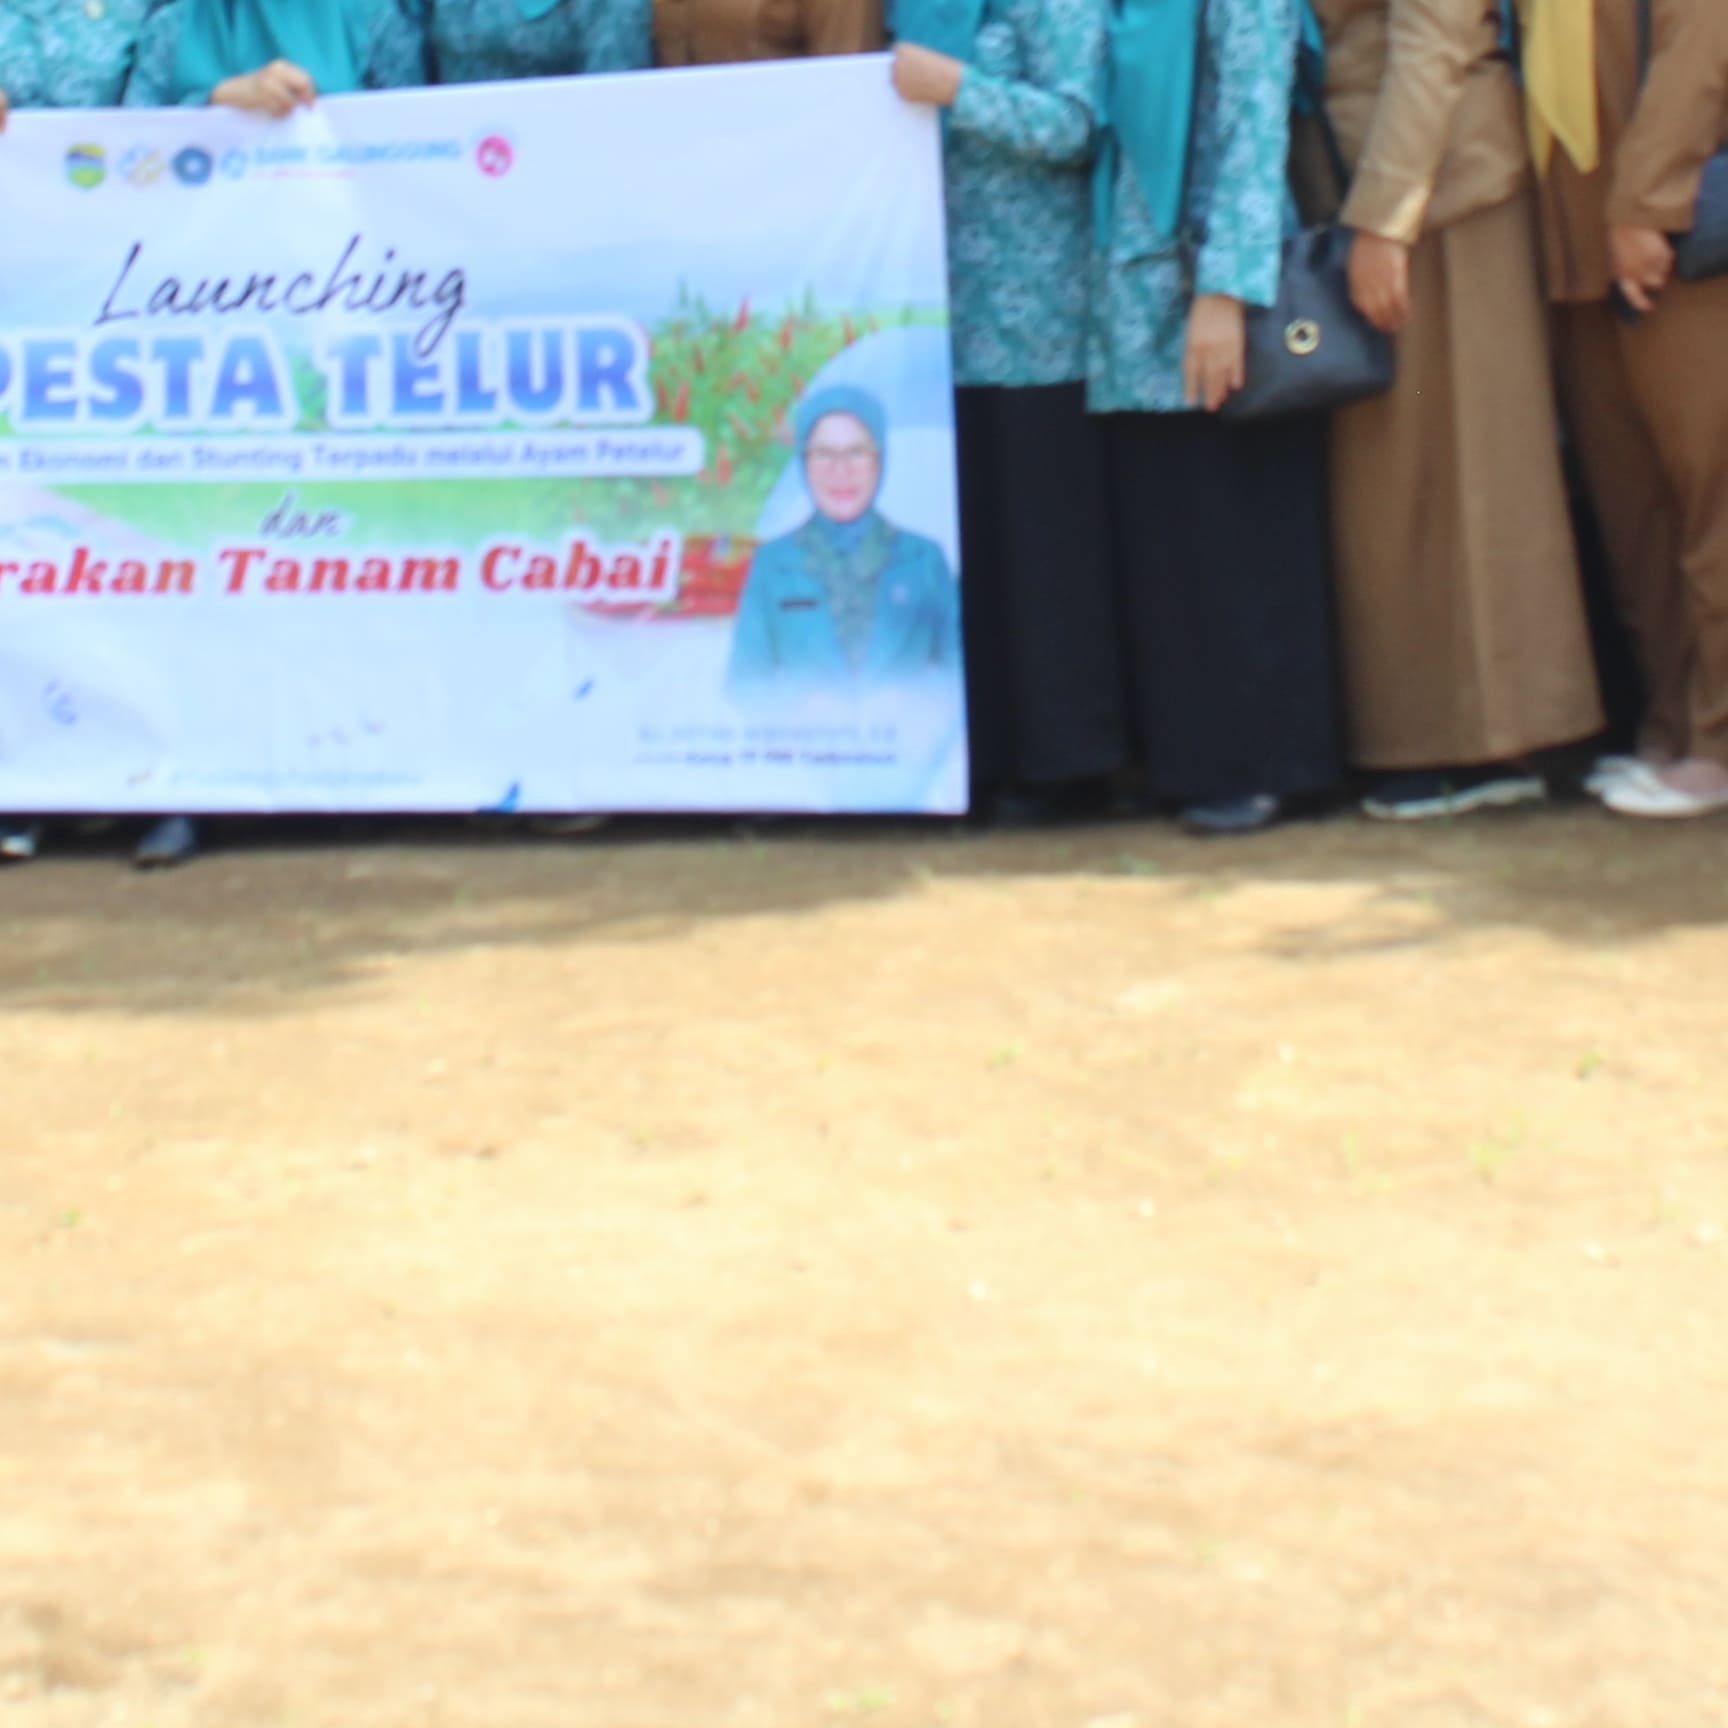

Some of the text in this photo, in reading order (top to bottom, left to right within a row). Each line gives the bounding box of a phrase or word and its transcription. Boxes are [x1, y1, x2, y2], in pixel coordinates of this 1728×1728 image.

[93, 233, 466, 358] Launching
[326, 326, 645, 419] TELUR
[258, 488, 342, 538] dan
[218, 546, 461, 594] Tanam
[479, 538, 672, 593] Cabai
